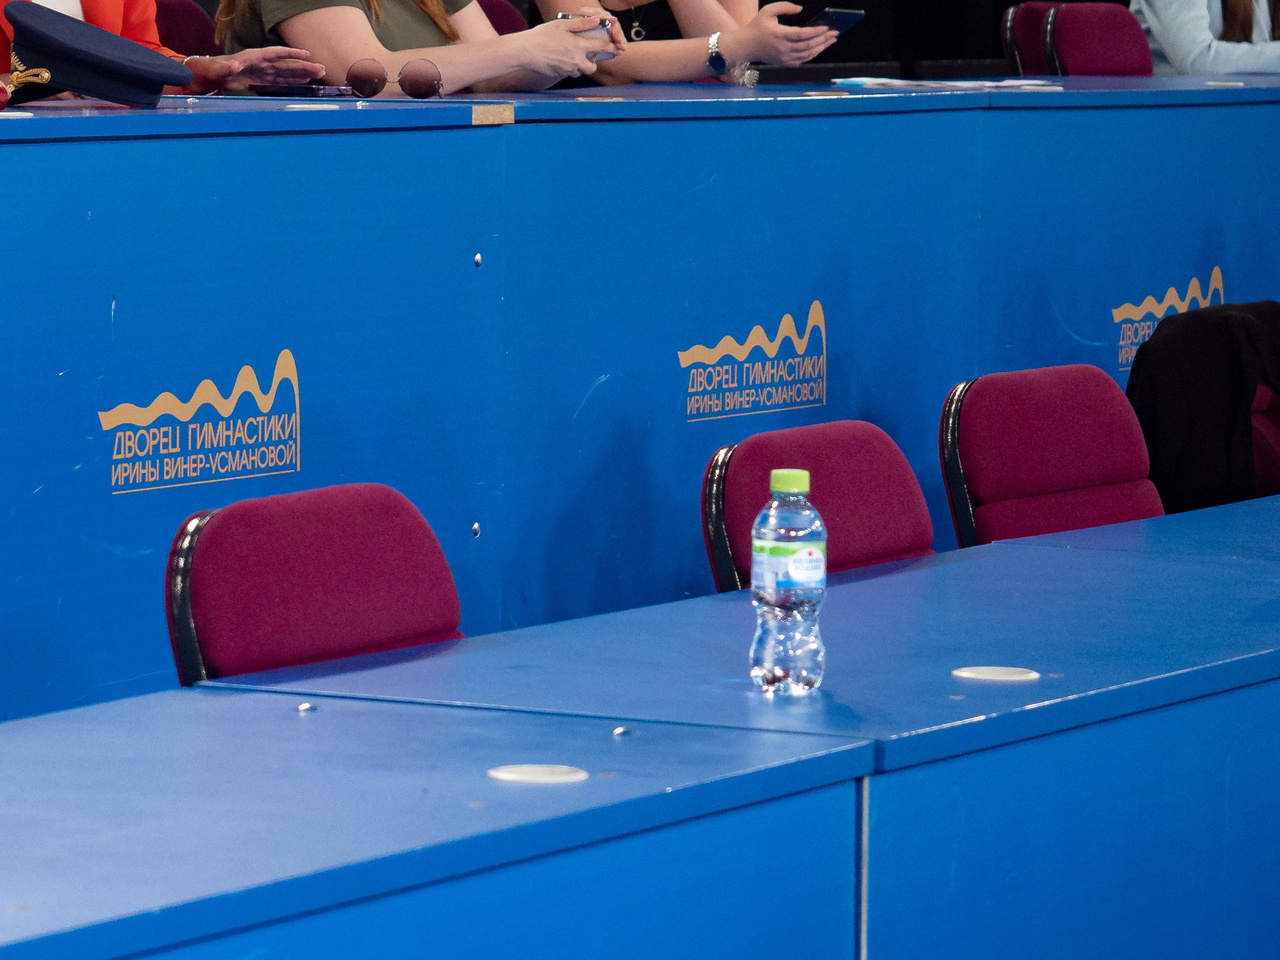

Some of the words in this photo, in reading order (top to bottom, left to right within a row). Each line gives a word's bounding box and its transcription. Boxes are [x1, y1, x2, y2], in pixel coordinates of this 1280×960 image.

[1118, 346, 1137, 363] ИРИ
[688, 365, 738, 393] ДВОРЕЦ
[743, 355, 823, 386] ГИМНАСТИКИ
[687, 393, 722, 415] ИРИНЫ
[725, 379, 823, 411] ВИНЕР-УСМАНОВОЙ
[112, 426, 181, 460] ДВОРЕЦ
[188, 413, 296, 451] ГИМНАСТИКИ
[111, 459, 159, 486] ИРИНЫ
[163, 441, 296, 480] ВИНЕР-УСМАНОВОЙ
